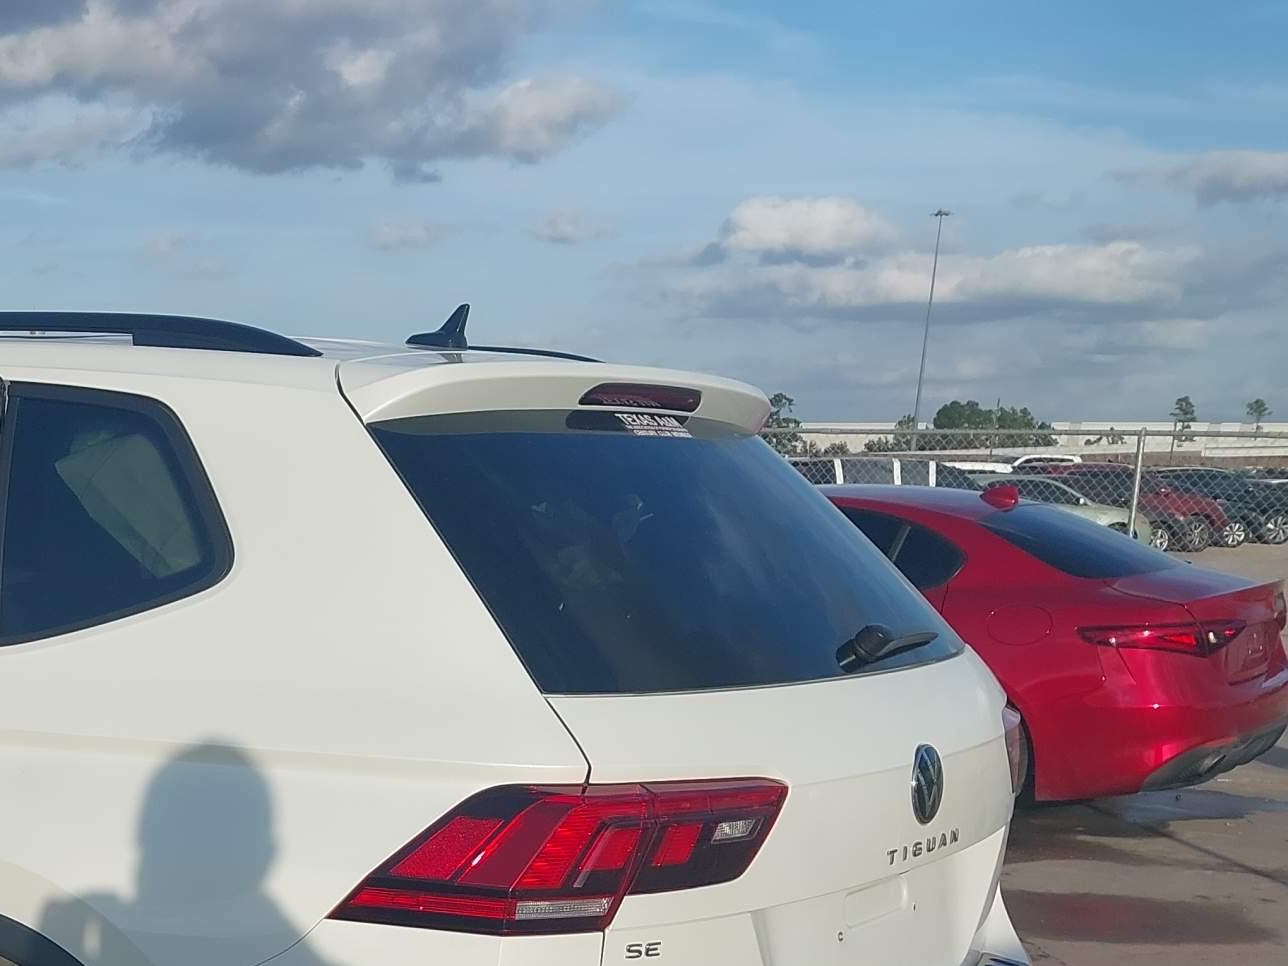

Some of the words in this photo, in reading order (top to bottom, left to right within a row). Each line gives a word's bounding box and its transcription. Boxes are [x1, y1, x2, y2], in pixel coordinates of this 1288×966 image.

[614, 412, 657, 426] TEXAS
[886, 827, 960, 866] TIGUAN
[624, 941, 662, 960] SE
